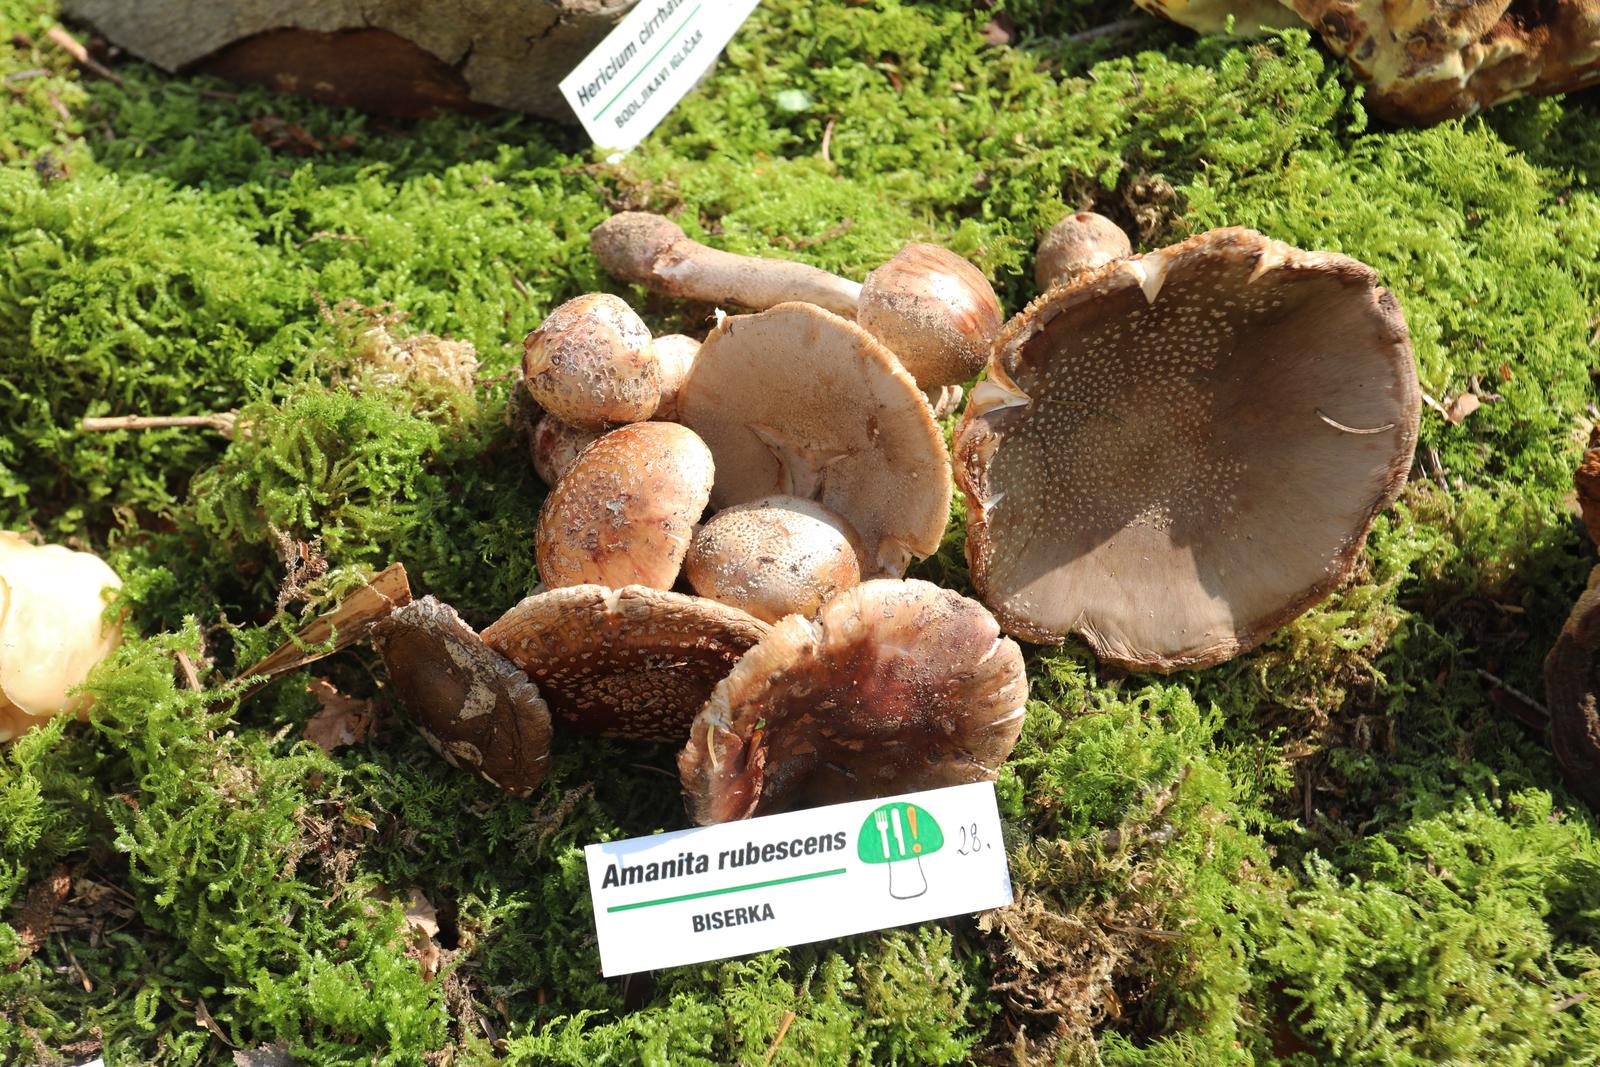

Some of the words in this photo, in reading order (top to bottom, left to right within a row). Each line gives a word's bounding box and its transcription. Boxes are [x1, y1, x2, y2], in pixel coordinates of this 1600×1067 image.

[577, 42, 637, 107] Hericium
[614, 67, 671, 129] BODLJIKAVI
[601, 853, 709, 889] Amanita
[718, 831, 847, 870] rubescens
[957, 823, 991, 856] 28.
[692, 903, 775, 933] BISERKA
